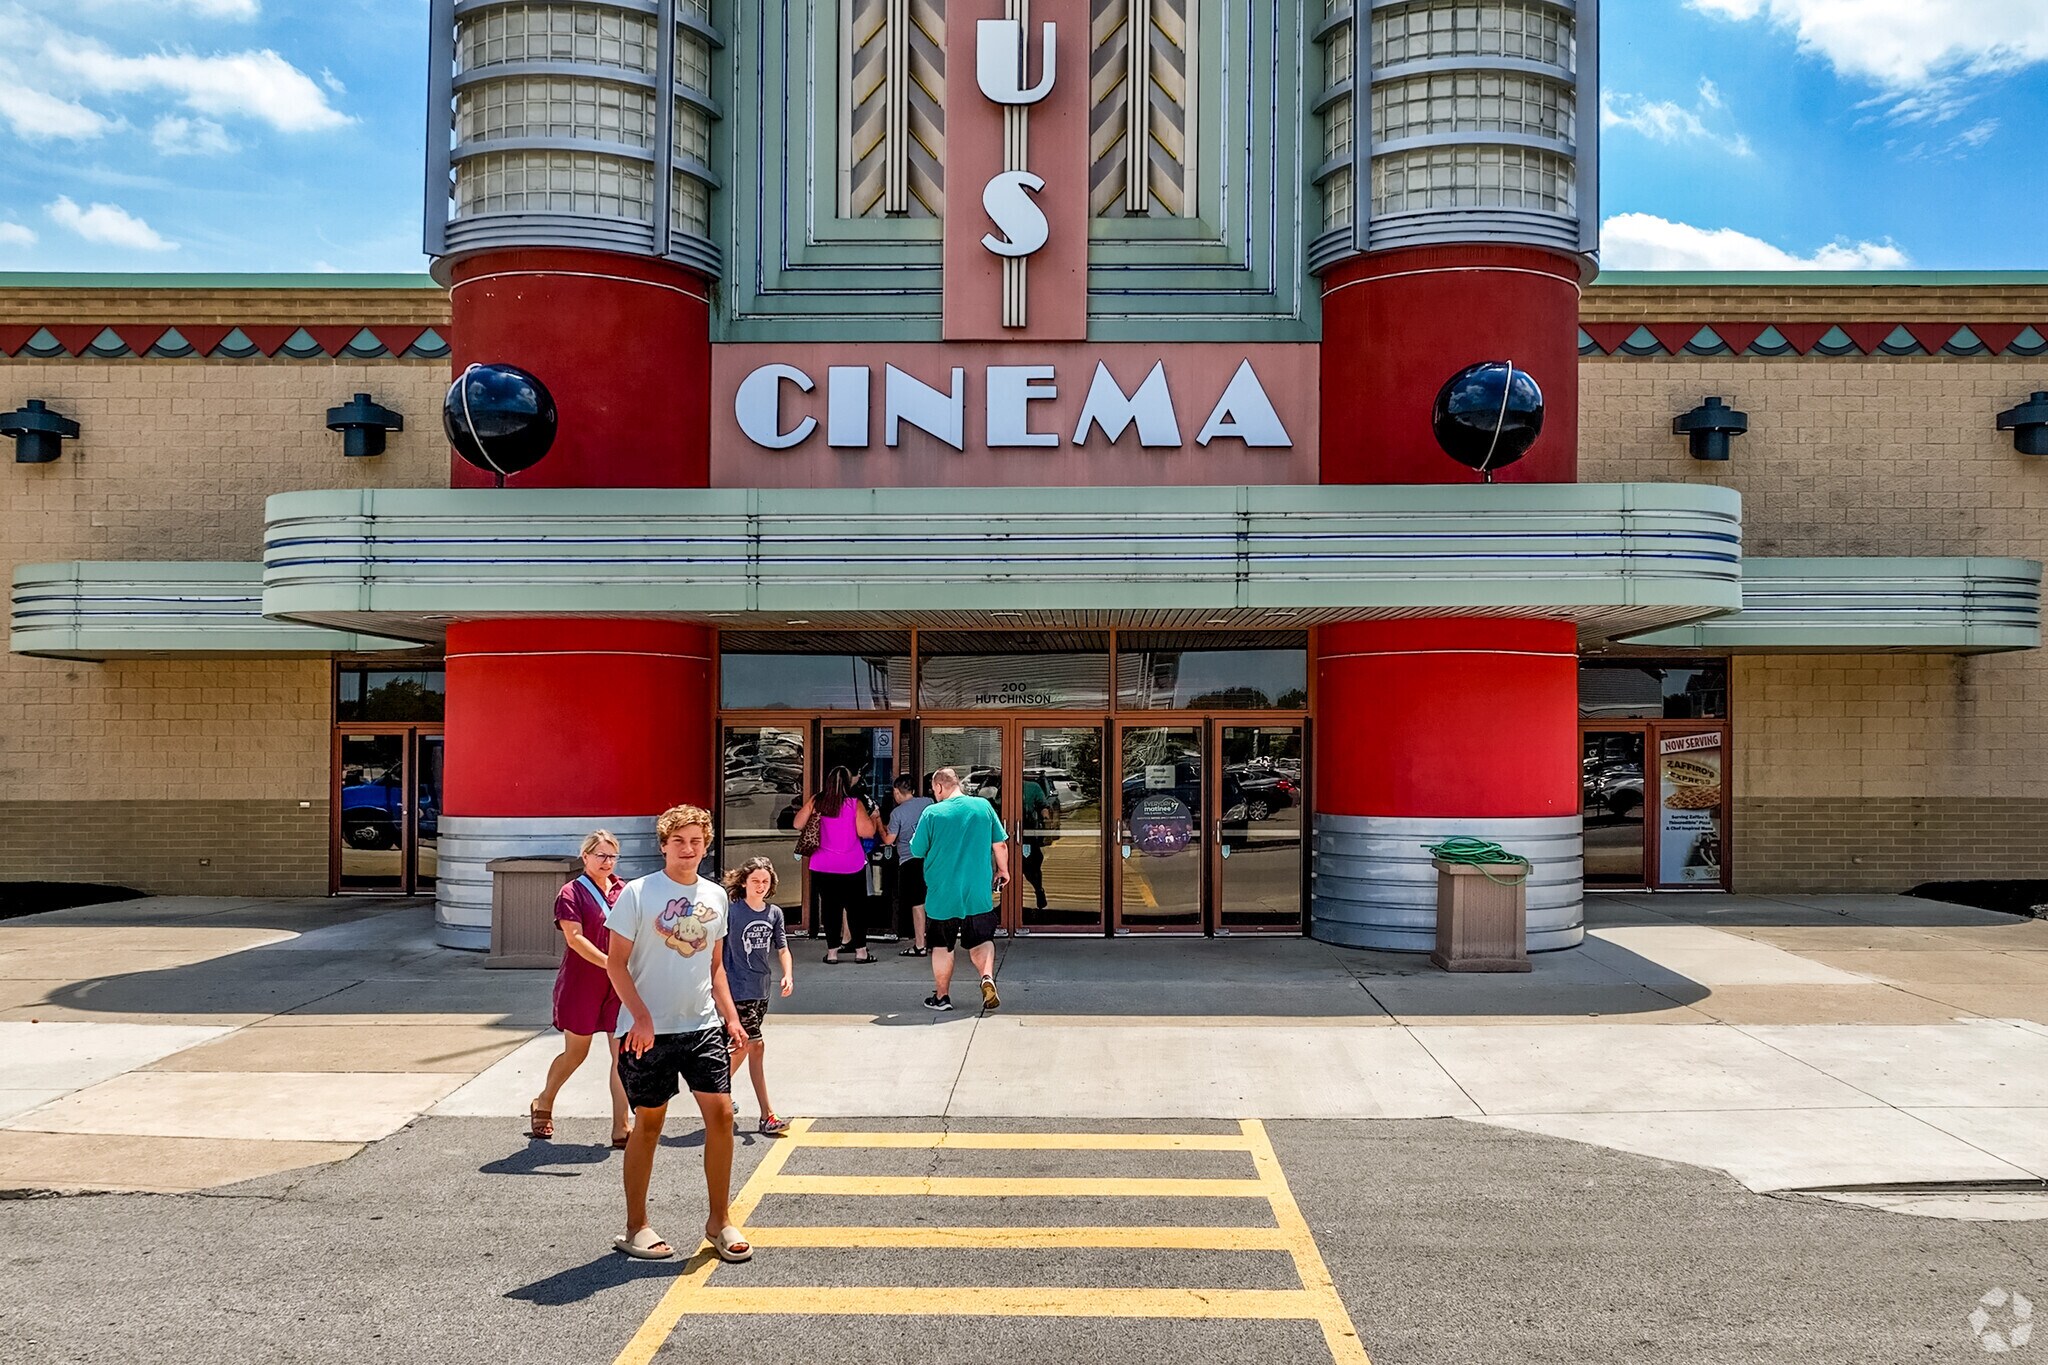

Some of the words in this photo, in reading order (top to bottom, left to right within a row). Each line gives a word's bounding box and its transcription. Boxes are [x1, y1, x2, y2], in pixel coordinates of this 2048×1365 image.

[734, 357, 1293, 452] CINEMA
[1001, 682, 1027, 692] 200
[975, 694, 1051, 704] HUTCHINSON
[1665, 739, 1685, 752] NOW
[1685, 735, 1719, 748] SERVING
[1666, 760, 1715, 779] ZAFFIRO'S
[1669, 771, 1711, 785] EXPRESS
[664, 897, 719, 923] Kirby
